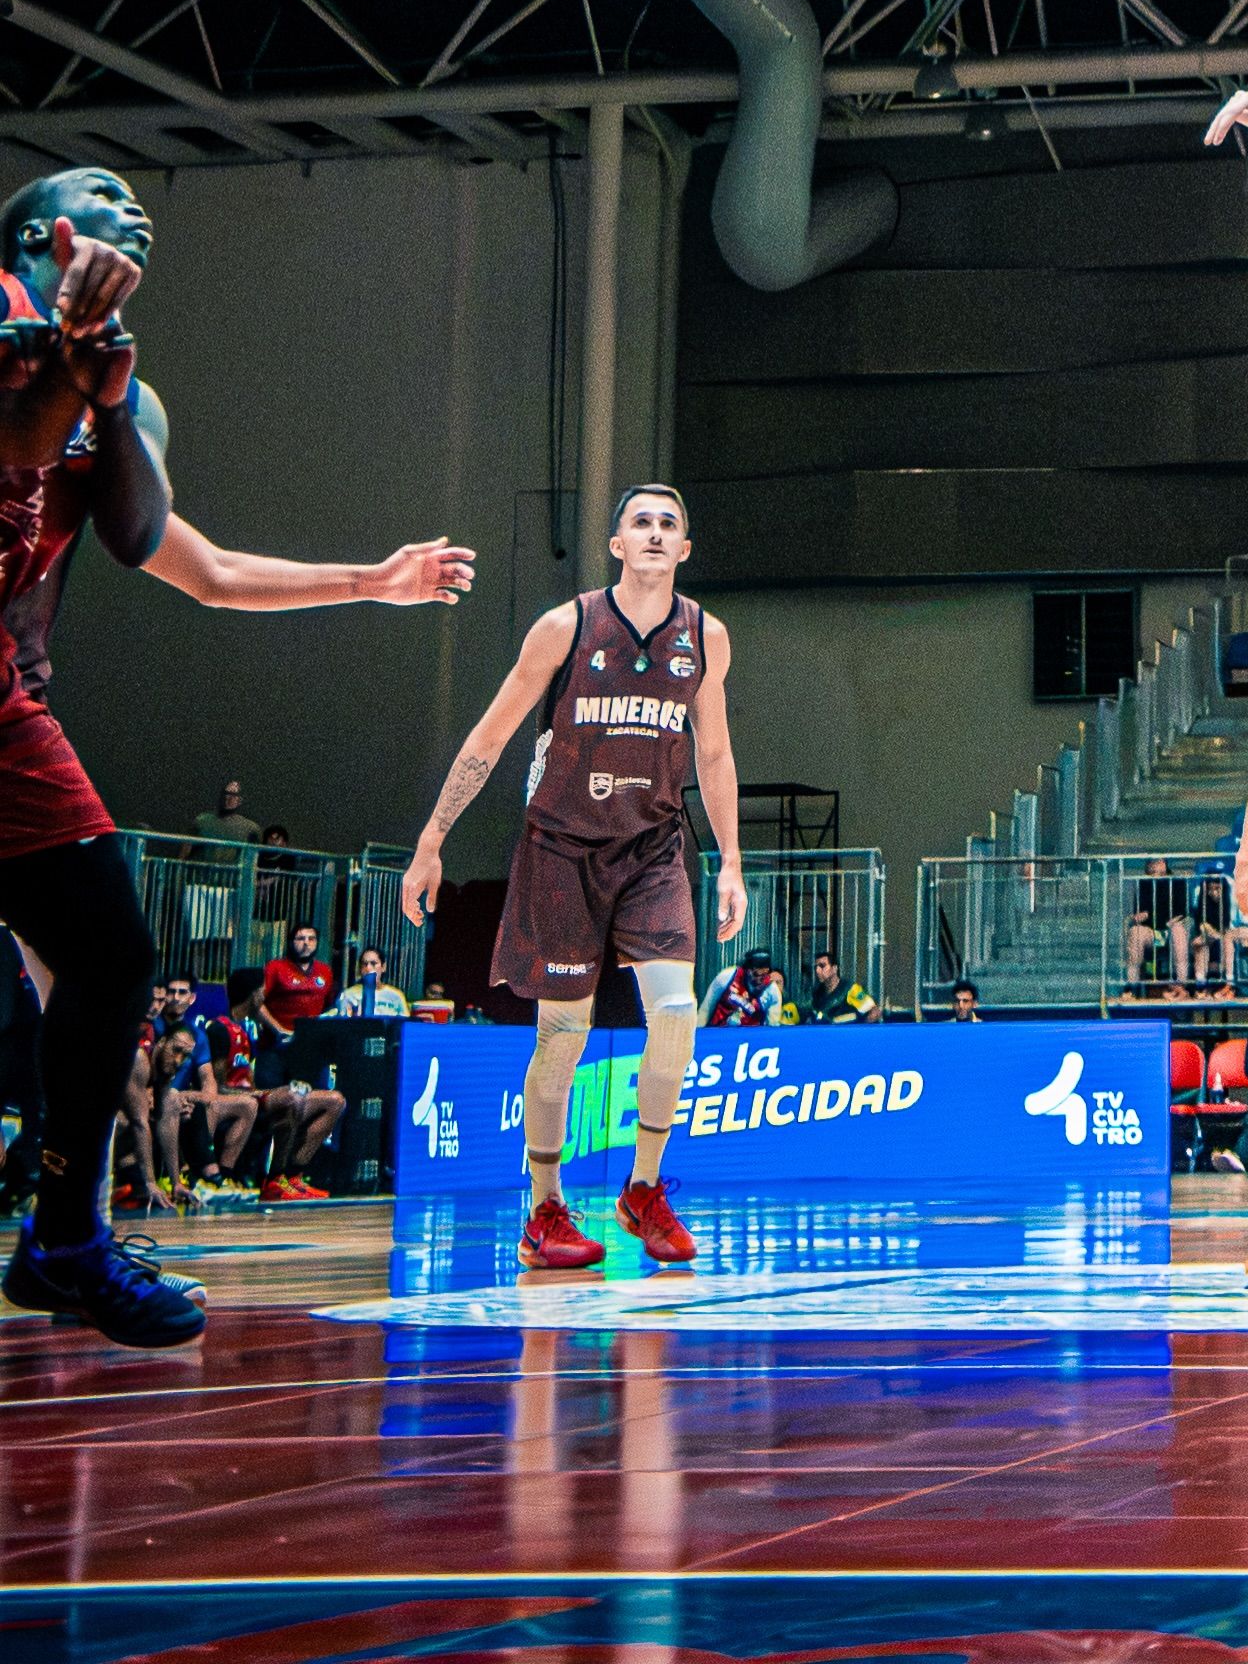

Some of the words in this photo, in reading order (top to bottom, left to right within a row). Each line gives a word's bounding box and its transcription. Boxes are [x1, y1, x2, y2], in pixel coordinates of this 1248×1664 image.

[590, 649, 607, 671] 4
[574, 695, 688, 733] MINEROS
[733, 1042, 781, 1083] la
[440, 1100, 454, 1120] TV
[671, 1069, 925, 1138] FELICIDAD
[1092, 1090, 1124, 1110] TV
[1092, 1108, 1140, 1128] CUA
[439, 1120, 459, 1139] CUA
[1092, 1126, 1143, 1146] TRO
[439, 1138, 460, 1159] TRO
